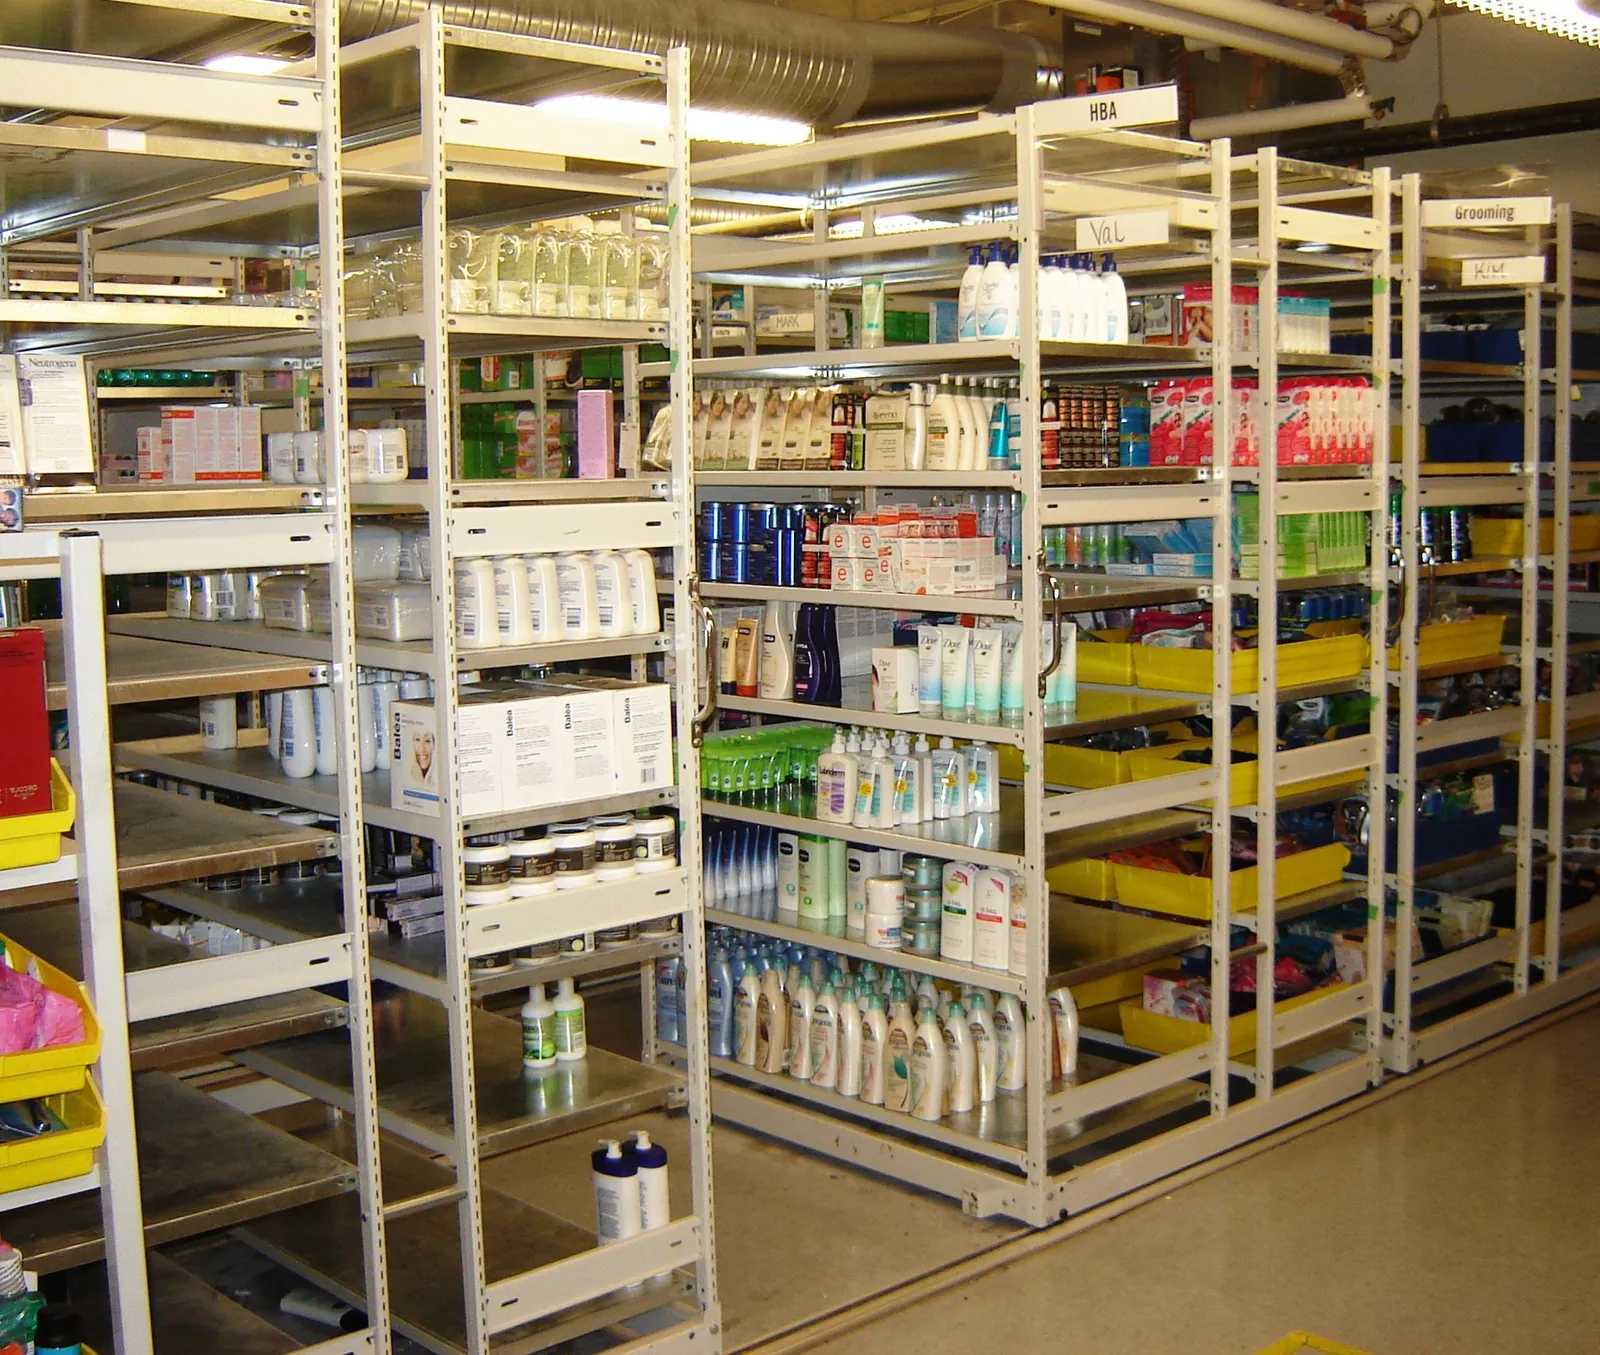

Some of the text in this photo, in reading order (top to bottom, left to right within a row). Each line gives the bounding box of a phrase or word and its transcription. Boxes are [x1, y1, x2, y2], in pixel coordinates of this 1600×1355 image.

[1089, 101, 1118, 122] HBA
[1455, 204, 1515, 222] Grooming
[29, 358, 77, 369] Neutrogena
[834, 535, 843, 548] e
[862, 536, 871, 549] e
[880, 559, 889, 573] e
[837, 568, 847, 581] e
[864, 569, 874, 582] e
[921, 635, 938, 645] Dove
[943, 638, 962, 648] Dove
[975, 640, 993, 650] Dove
